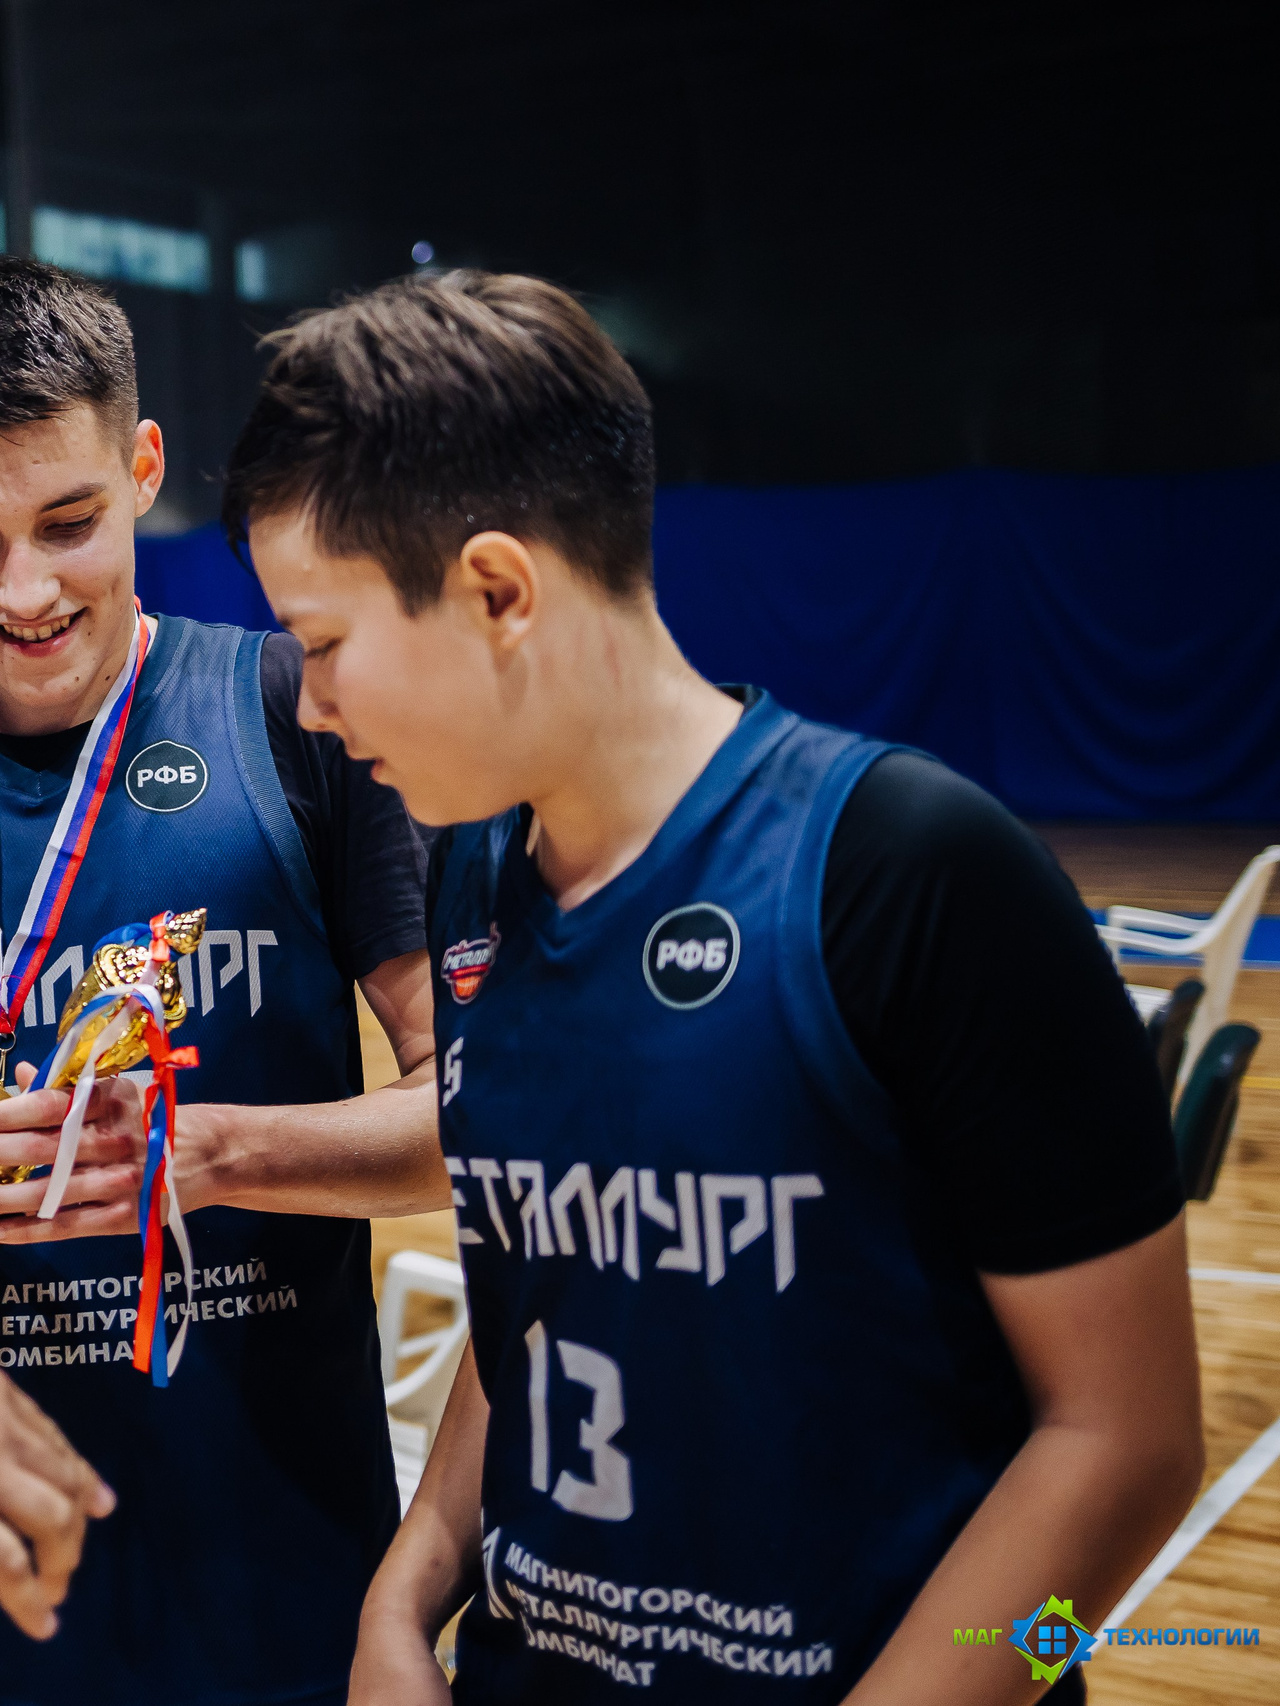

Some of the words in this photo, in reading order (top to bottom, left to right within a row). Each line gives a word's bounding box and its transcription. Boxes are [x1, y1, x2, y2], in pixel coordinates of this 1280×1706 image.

[136, 764, 197, 788] РФБ
[655, 937, 729, 972] РФБ
[444, 1156, 825, 1294] ЕТАЛЛУРГ
[524, 1319, 634, 1522] 13
[505, 1542, 794, 1638] МАГНИТОГОРСКИЙ
[520, 1611, 655, 1687] МБИНАТ
